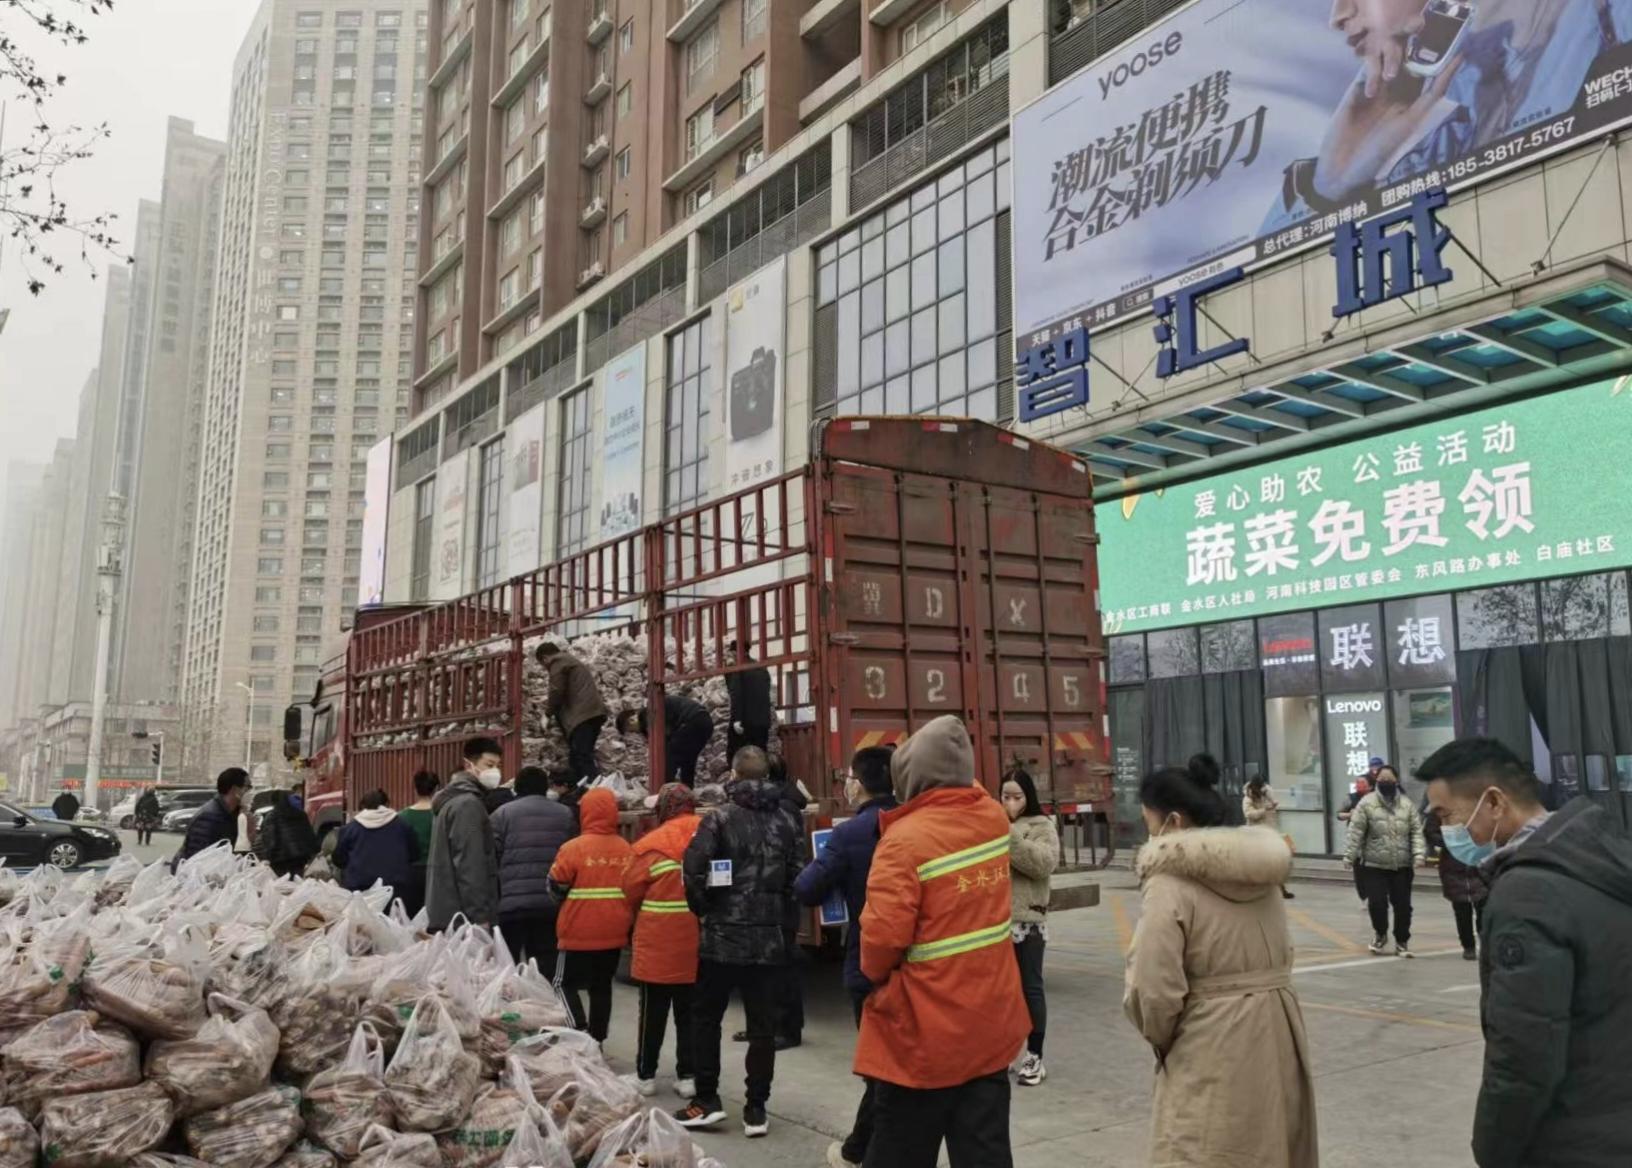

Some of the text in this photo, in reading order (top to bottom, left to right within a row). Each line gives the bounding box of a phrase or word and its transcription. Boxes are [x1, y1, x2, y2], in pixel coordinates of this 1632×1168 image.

[1098, 31, 1183, 100] yoose
[1044, 70, 1232, 214] 潮流便携
[1044, 105, 1268, 262] 合金剃须刀
[1016, 186, 1453, 423] 智汇城
[1194, 420, 1516, 519] 爱心助农 公益活动
[1186, 461, 1536, 586] 蔬菜免费领
[1181, 589, 1256, 613] 金水区人社局
[1266, 567, 1402, 599] 河南科技园区管委会
[1415, 549, 1522, 579] 东风路办事处
[1536, 535, 1615, 561] 白庙社区
[1330, 616, 1446, 671] 联想
[1327, 700, 1382, 714] Lenovo
[1343, 721, 1370, 794] 联想
